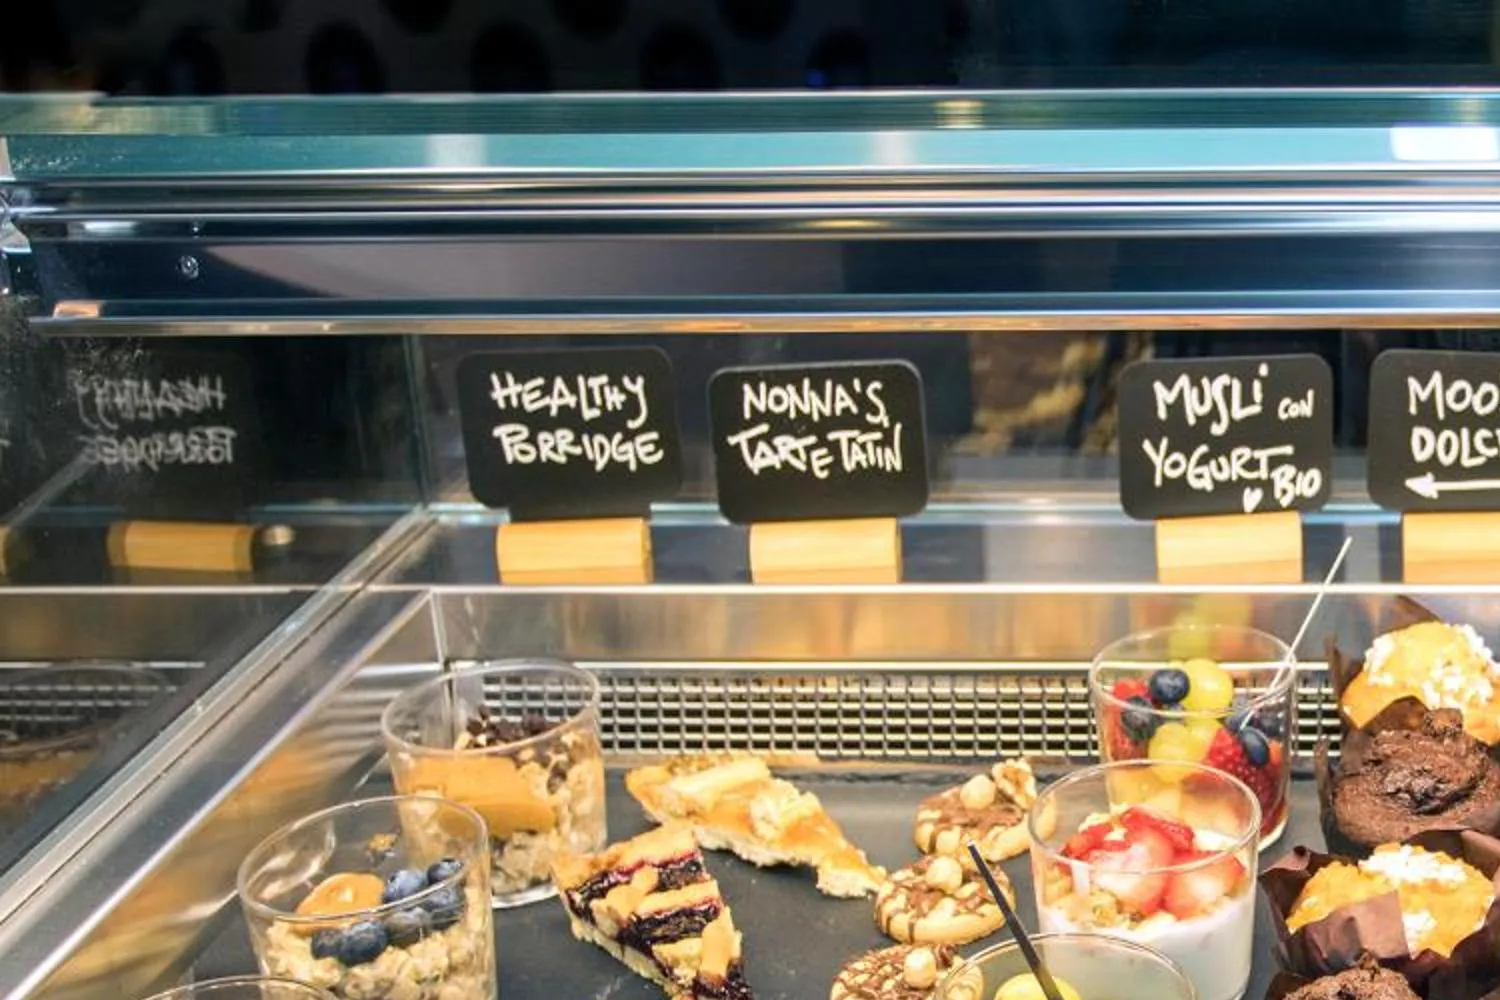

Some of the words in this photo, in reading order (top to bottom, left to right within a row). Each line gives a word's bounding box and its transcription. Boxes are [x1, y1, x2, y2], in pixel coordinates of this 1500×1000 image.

[490, 372, 647, 428] HEALTHY
[742, 376, 888, 428] NONNA'S
[1277, 388, 1315, 421] CON
[492, 424, 664, 472] PORRIDGE
[727, 422, 834, 479] TARTE
[828, 422, 904, 475] TATIN
[1142, 437, 1294, 491] YOGURT
[1270, 464, 1322, 508] BIO
